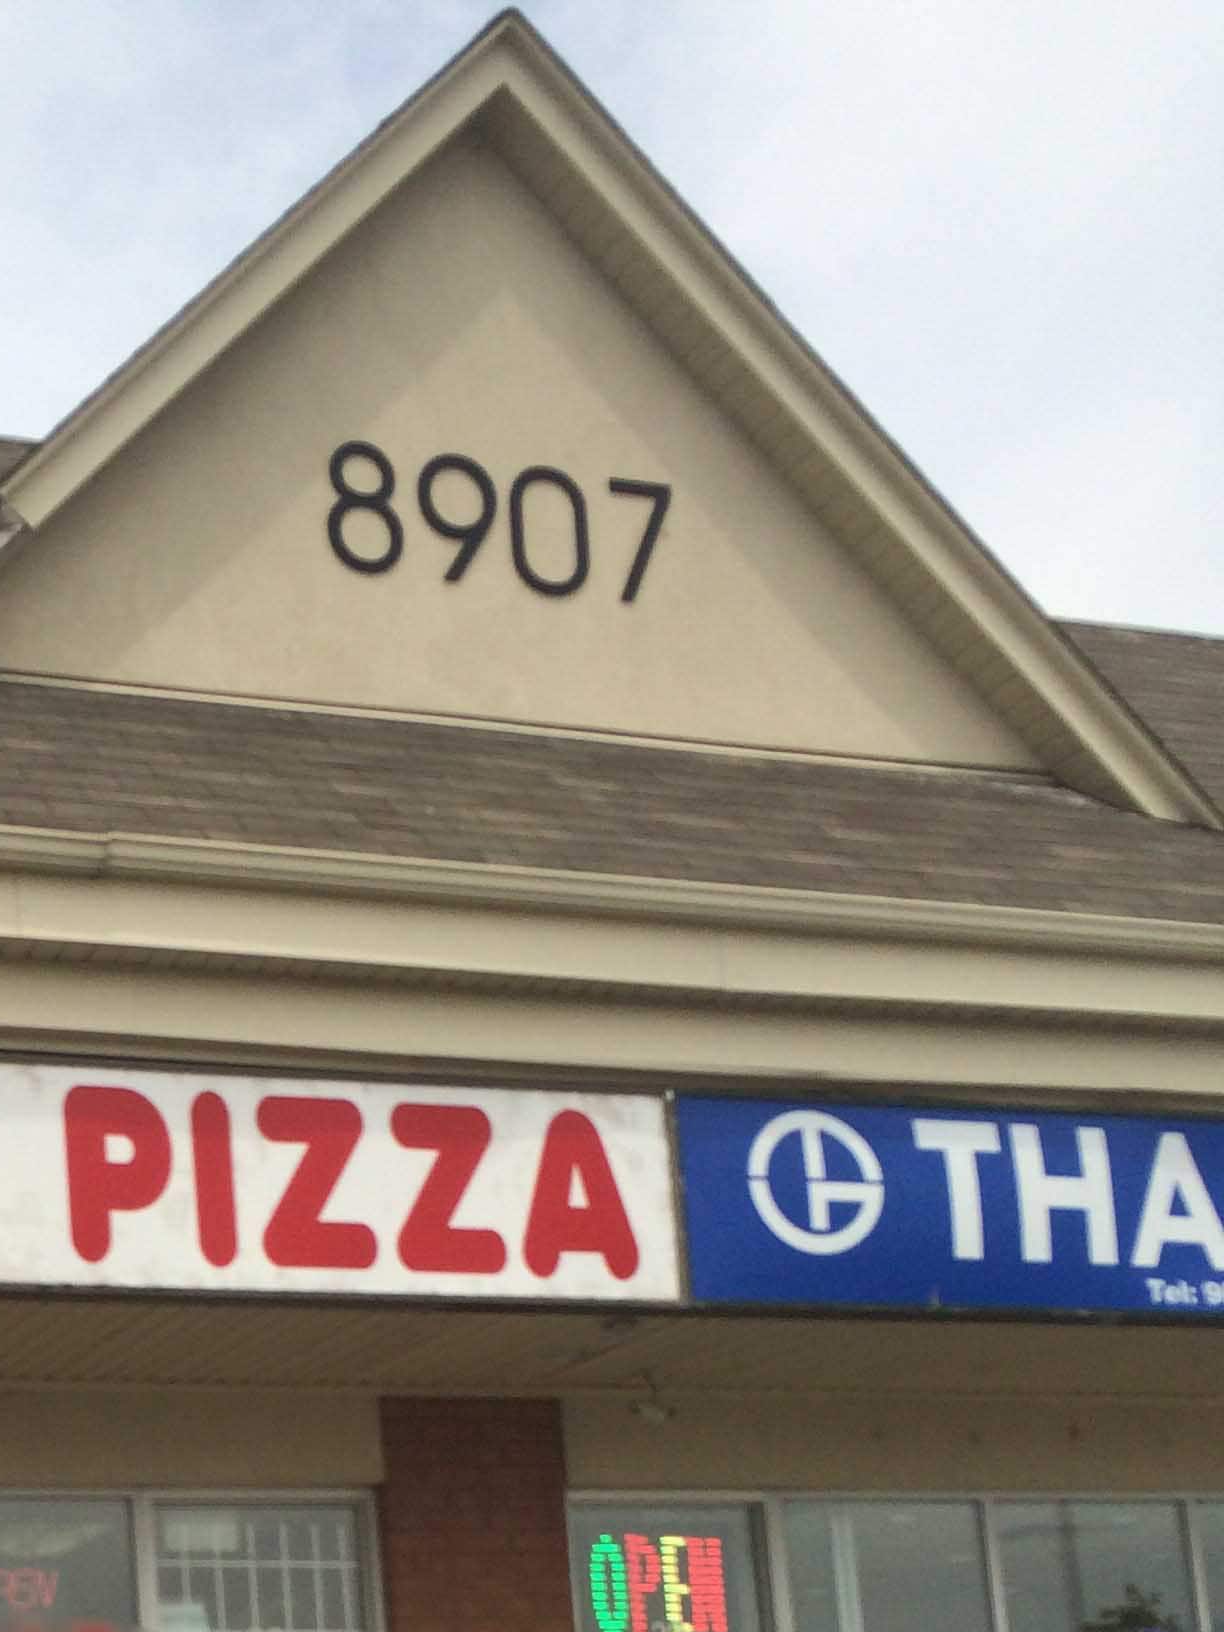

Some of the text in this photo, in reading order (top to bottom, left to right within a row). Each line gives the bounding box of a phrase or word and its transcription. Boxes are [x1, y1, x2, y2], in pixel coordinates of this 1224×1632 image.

[327, 440, 672, 603] 8907
[64, 1084, 640, 1281] PIZZA
[911, 1118, 1224, 1272] THA
[1145, 1278, 1198, 1305] Tel:
